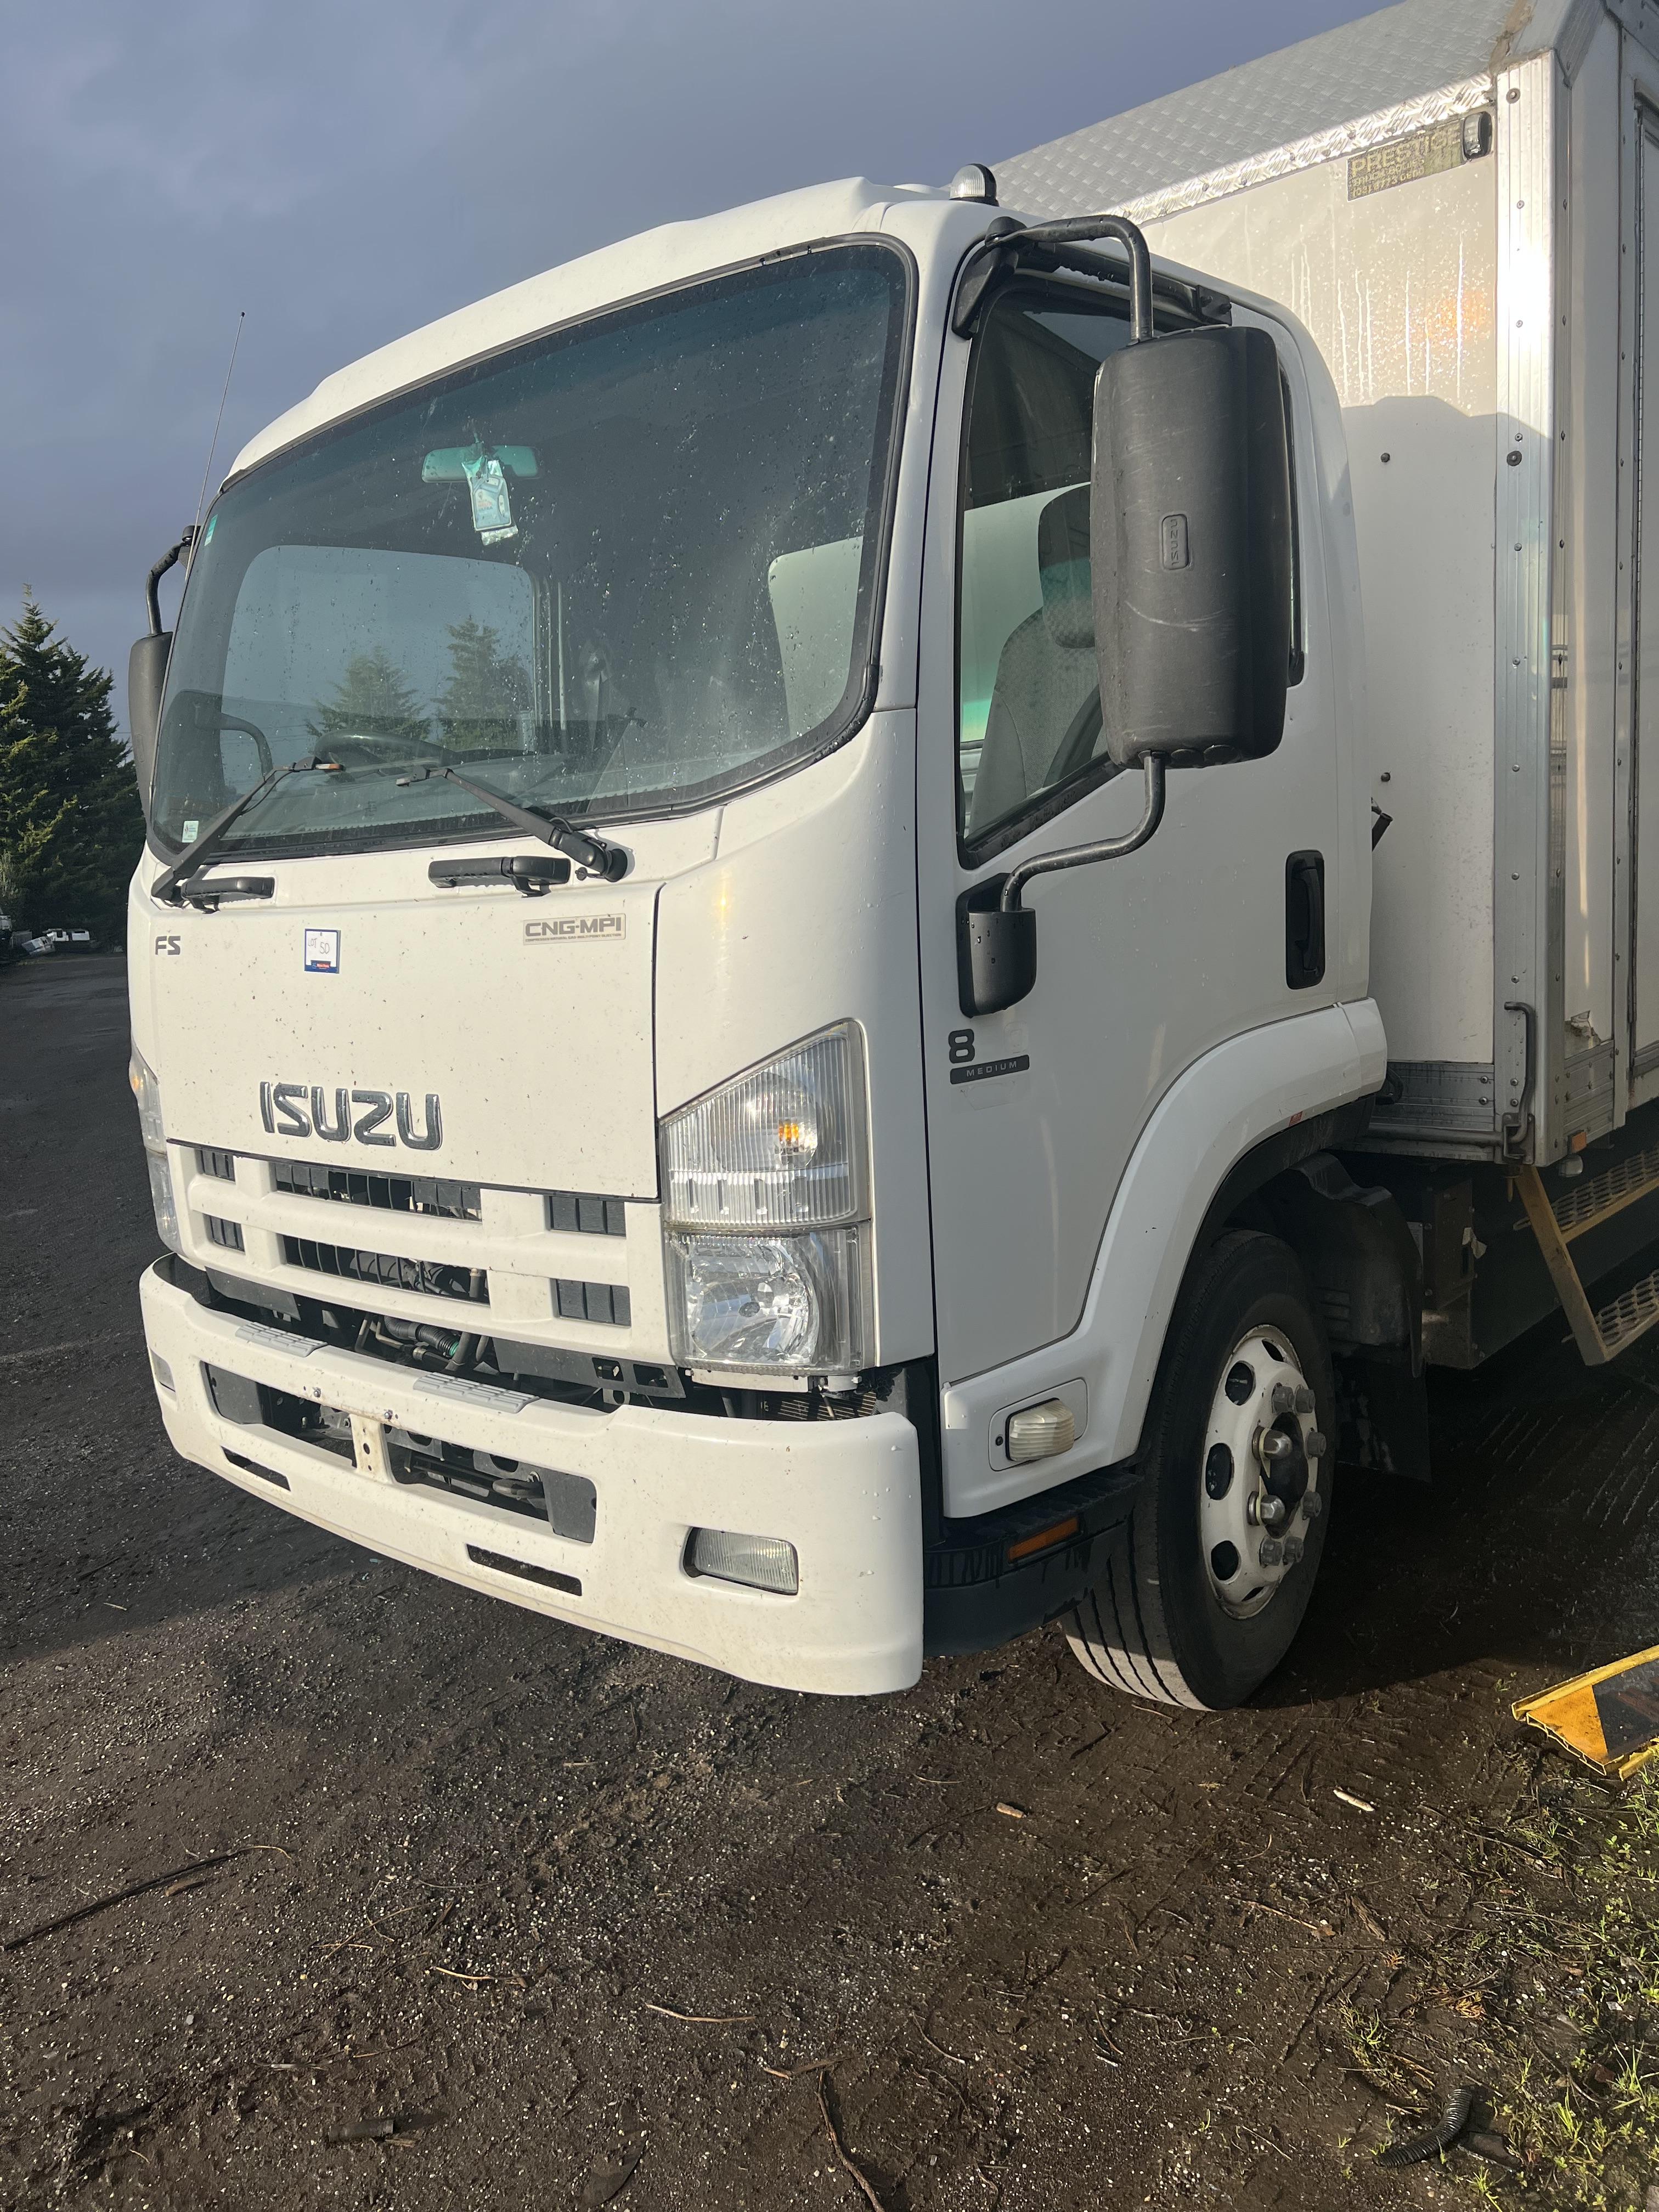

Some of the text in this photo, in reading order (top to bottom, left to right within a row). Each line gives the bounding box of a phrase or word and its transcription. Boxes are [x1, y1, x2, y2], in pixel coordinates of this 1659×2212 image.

[1351, 123, 1460, 178] PRESTIGE
[1170, 518, 1180, 567] ISUZU
[525, 917, 621, 936] CNG-MPI
[155, 935, 180, 955] FS
[308, 938, 317, 948] LOT
[948, 1028, 975, 1064] 8
[966, 1060, 1017, 1077] MEDIUM
[260, 1081, 442, 1150] ISUZU
